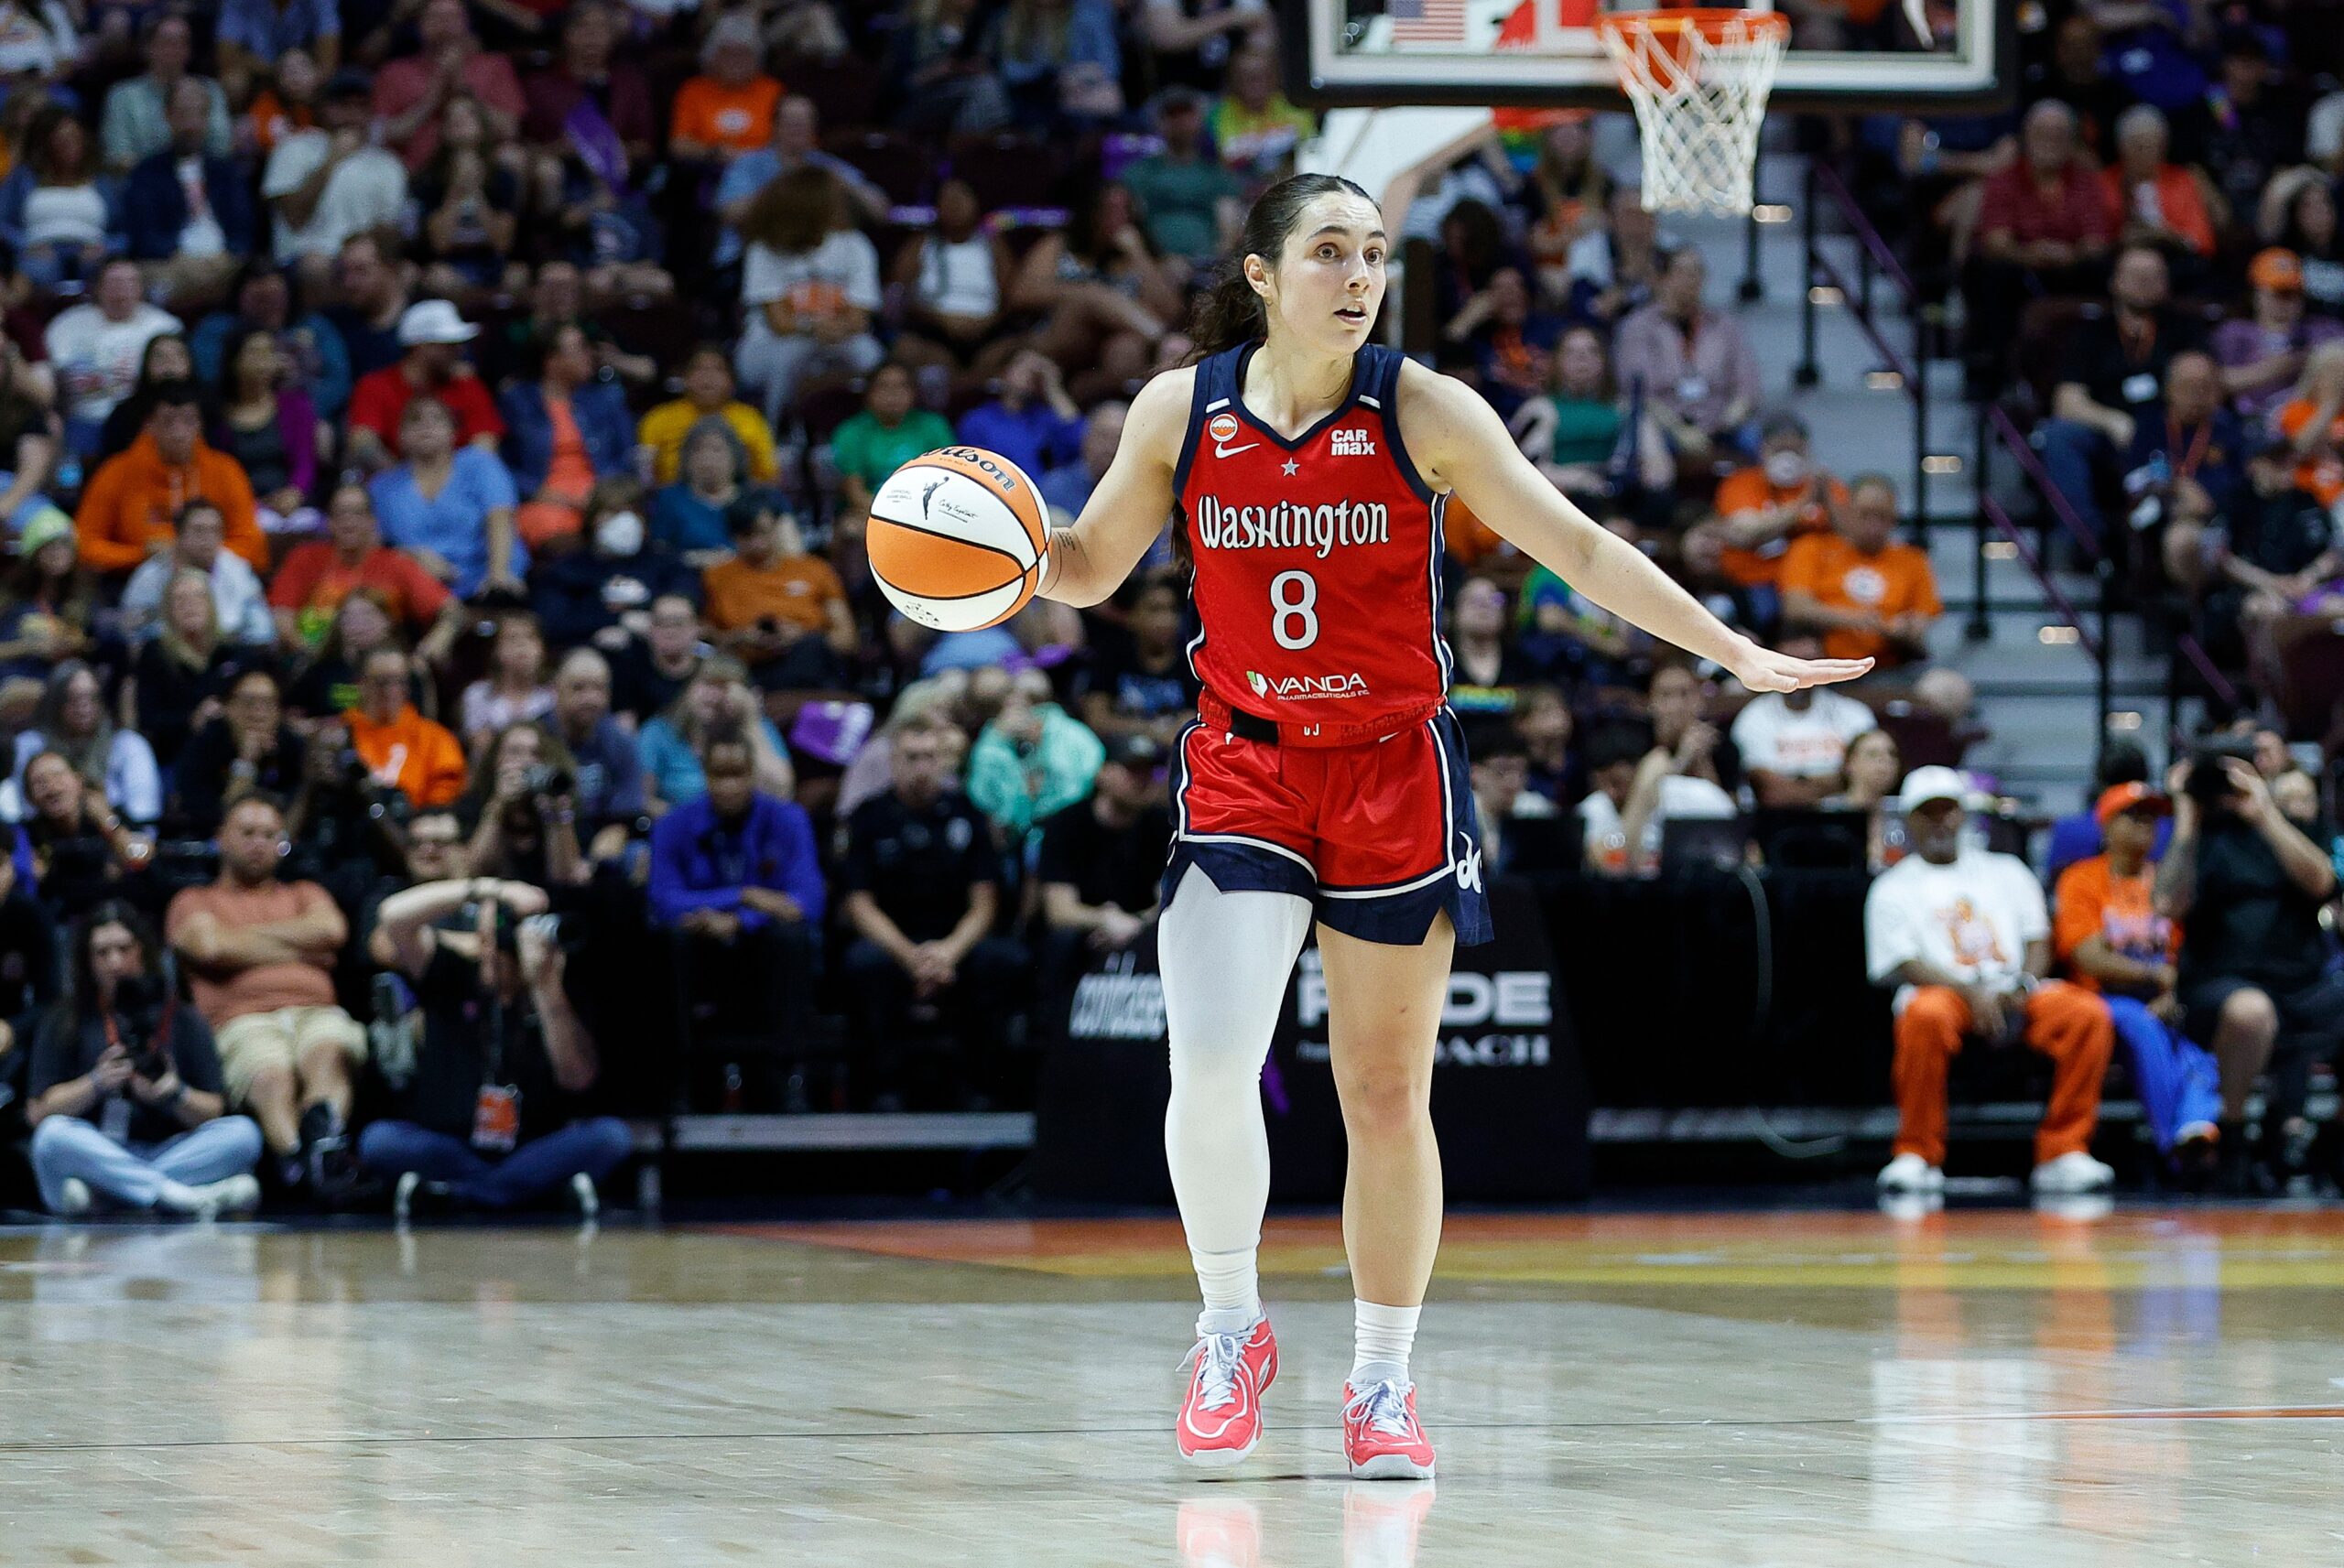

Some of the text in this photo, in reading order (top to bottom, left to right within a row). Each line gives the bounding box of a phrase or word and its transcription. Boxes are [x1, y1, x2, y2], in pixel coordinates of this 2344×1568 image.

[1331, 429, 1368, 442] CAR
[1331, 442, 1376, 456] max
[1270, 569, 1319, 650] 8
[1268, 673, 1368, 695] VANDA
